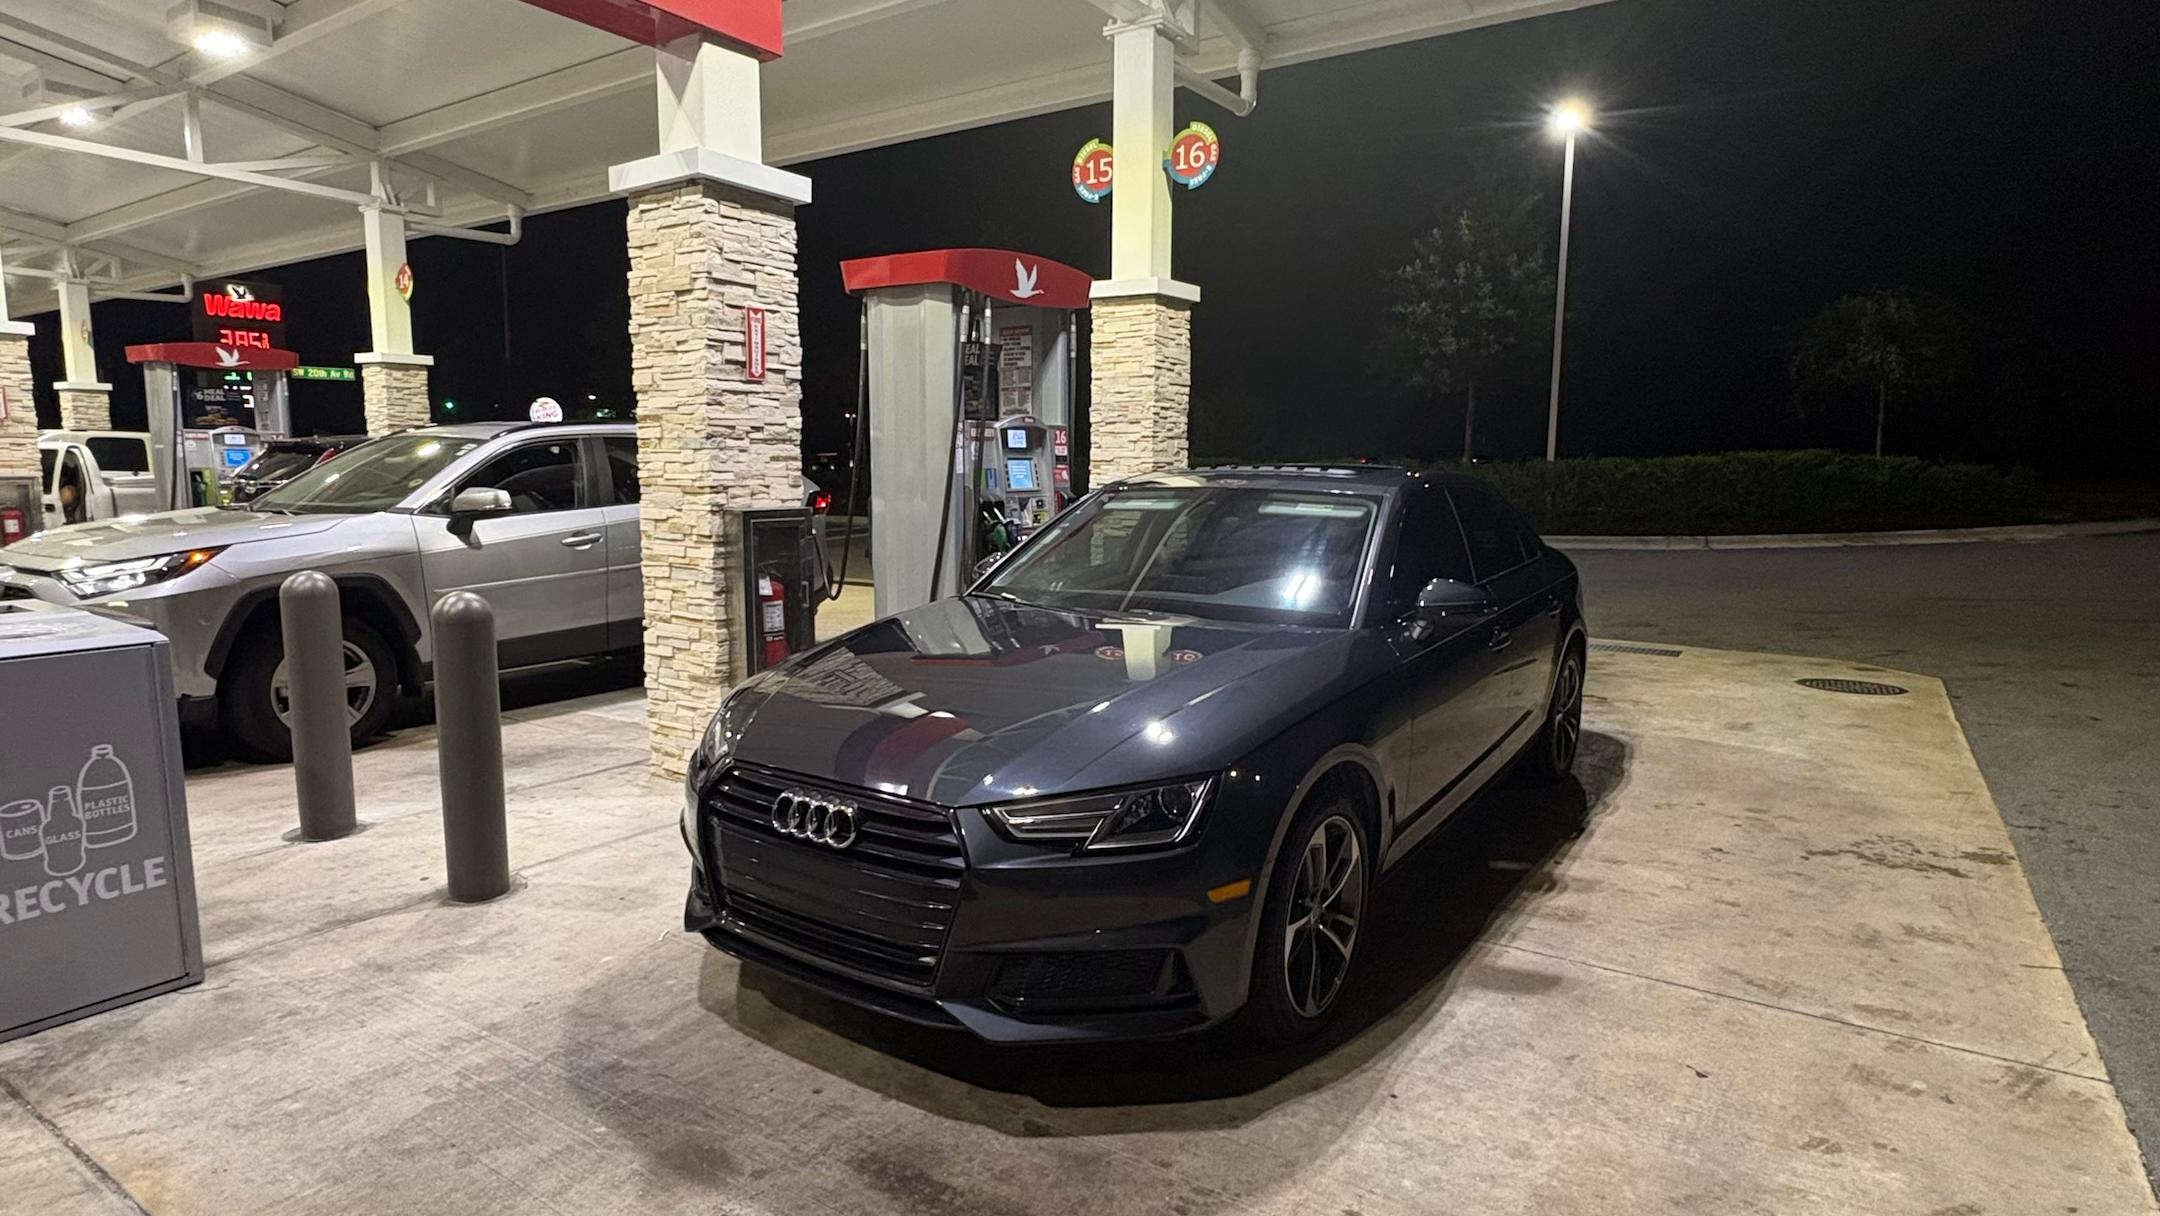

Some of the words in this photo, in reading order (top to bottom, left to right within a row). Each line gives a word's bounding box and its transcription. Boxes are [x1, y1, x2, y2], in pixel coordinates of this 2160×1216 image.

[1191, 124, 1214, 141] DIESEL
[1175, 142, 1206, 170] 16
[1086, 157, 1113, 184] 15
[203, 293, 281, 321] Wawa
[292, 368, 304, 377] SW
[308, 369, 327, 377] 20th
[1056, 430, 1067, 444] 16
[84, 795, 129, 811] PLASTIC
[85, 804, 130, 820] BOTTLES
[6, 825, 38, 839] CANS
[45, 830, 81, 845] GLASS
[0, 856, 167, 925] RECYCLE
